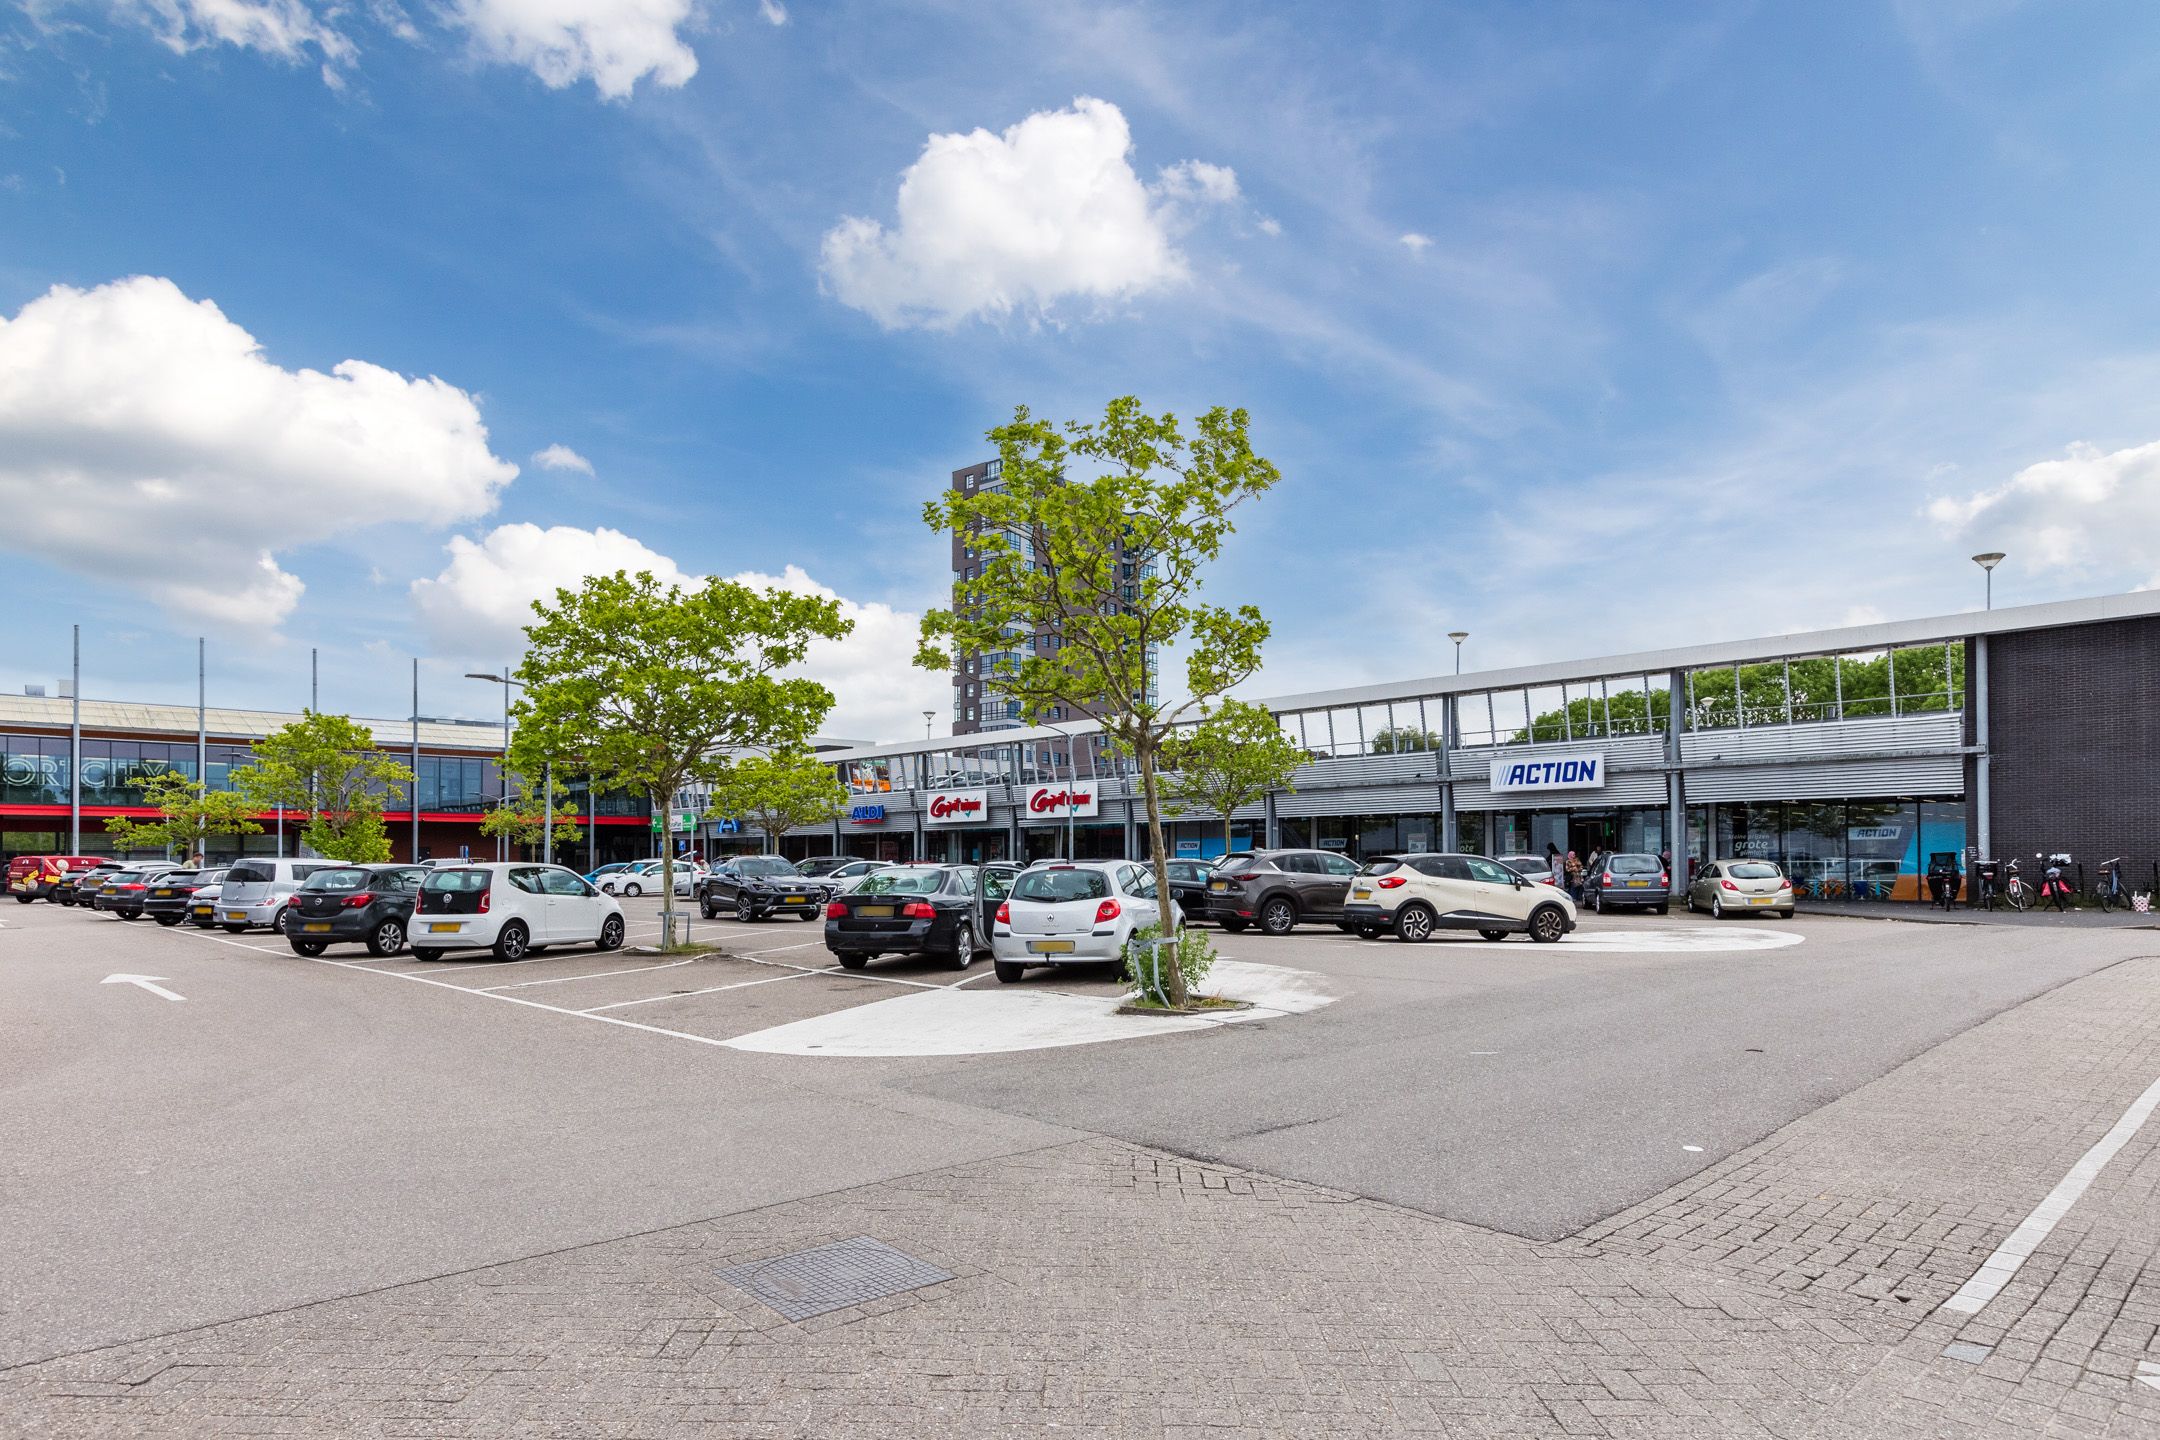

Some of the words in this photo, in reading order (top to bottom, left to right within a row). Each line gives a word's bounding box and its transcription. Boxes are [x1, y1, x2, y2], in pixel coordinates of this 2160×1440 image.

[1508, 760, 1596, 785] ACTION
[852, 805, 885, 820] ALDI
[1857, 828, 1896, 838] ACTION
[1324, 839, 1346, 848] ACTION
[1734, 840, 1768, 851] grote
